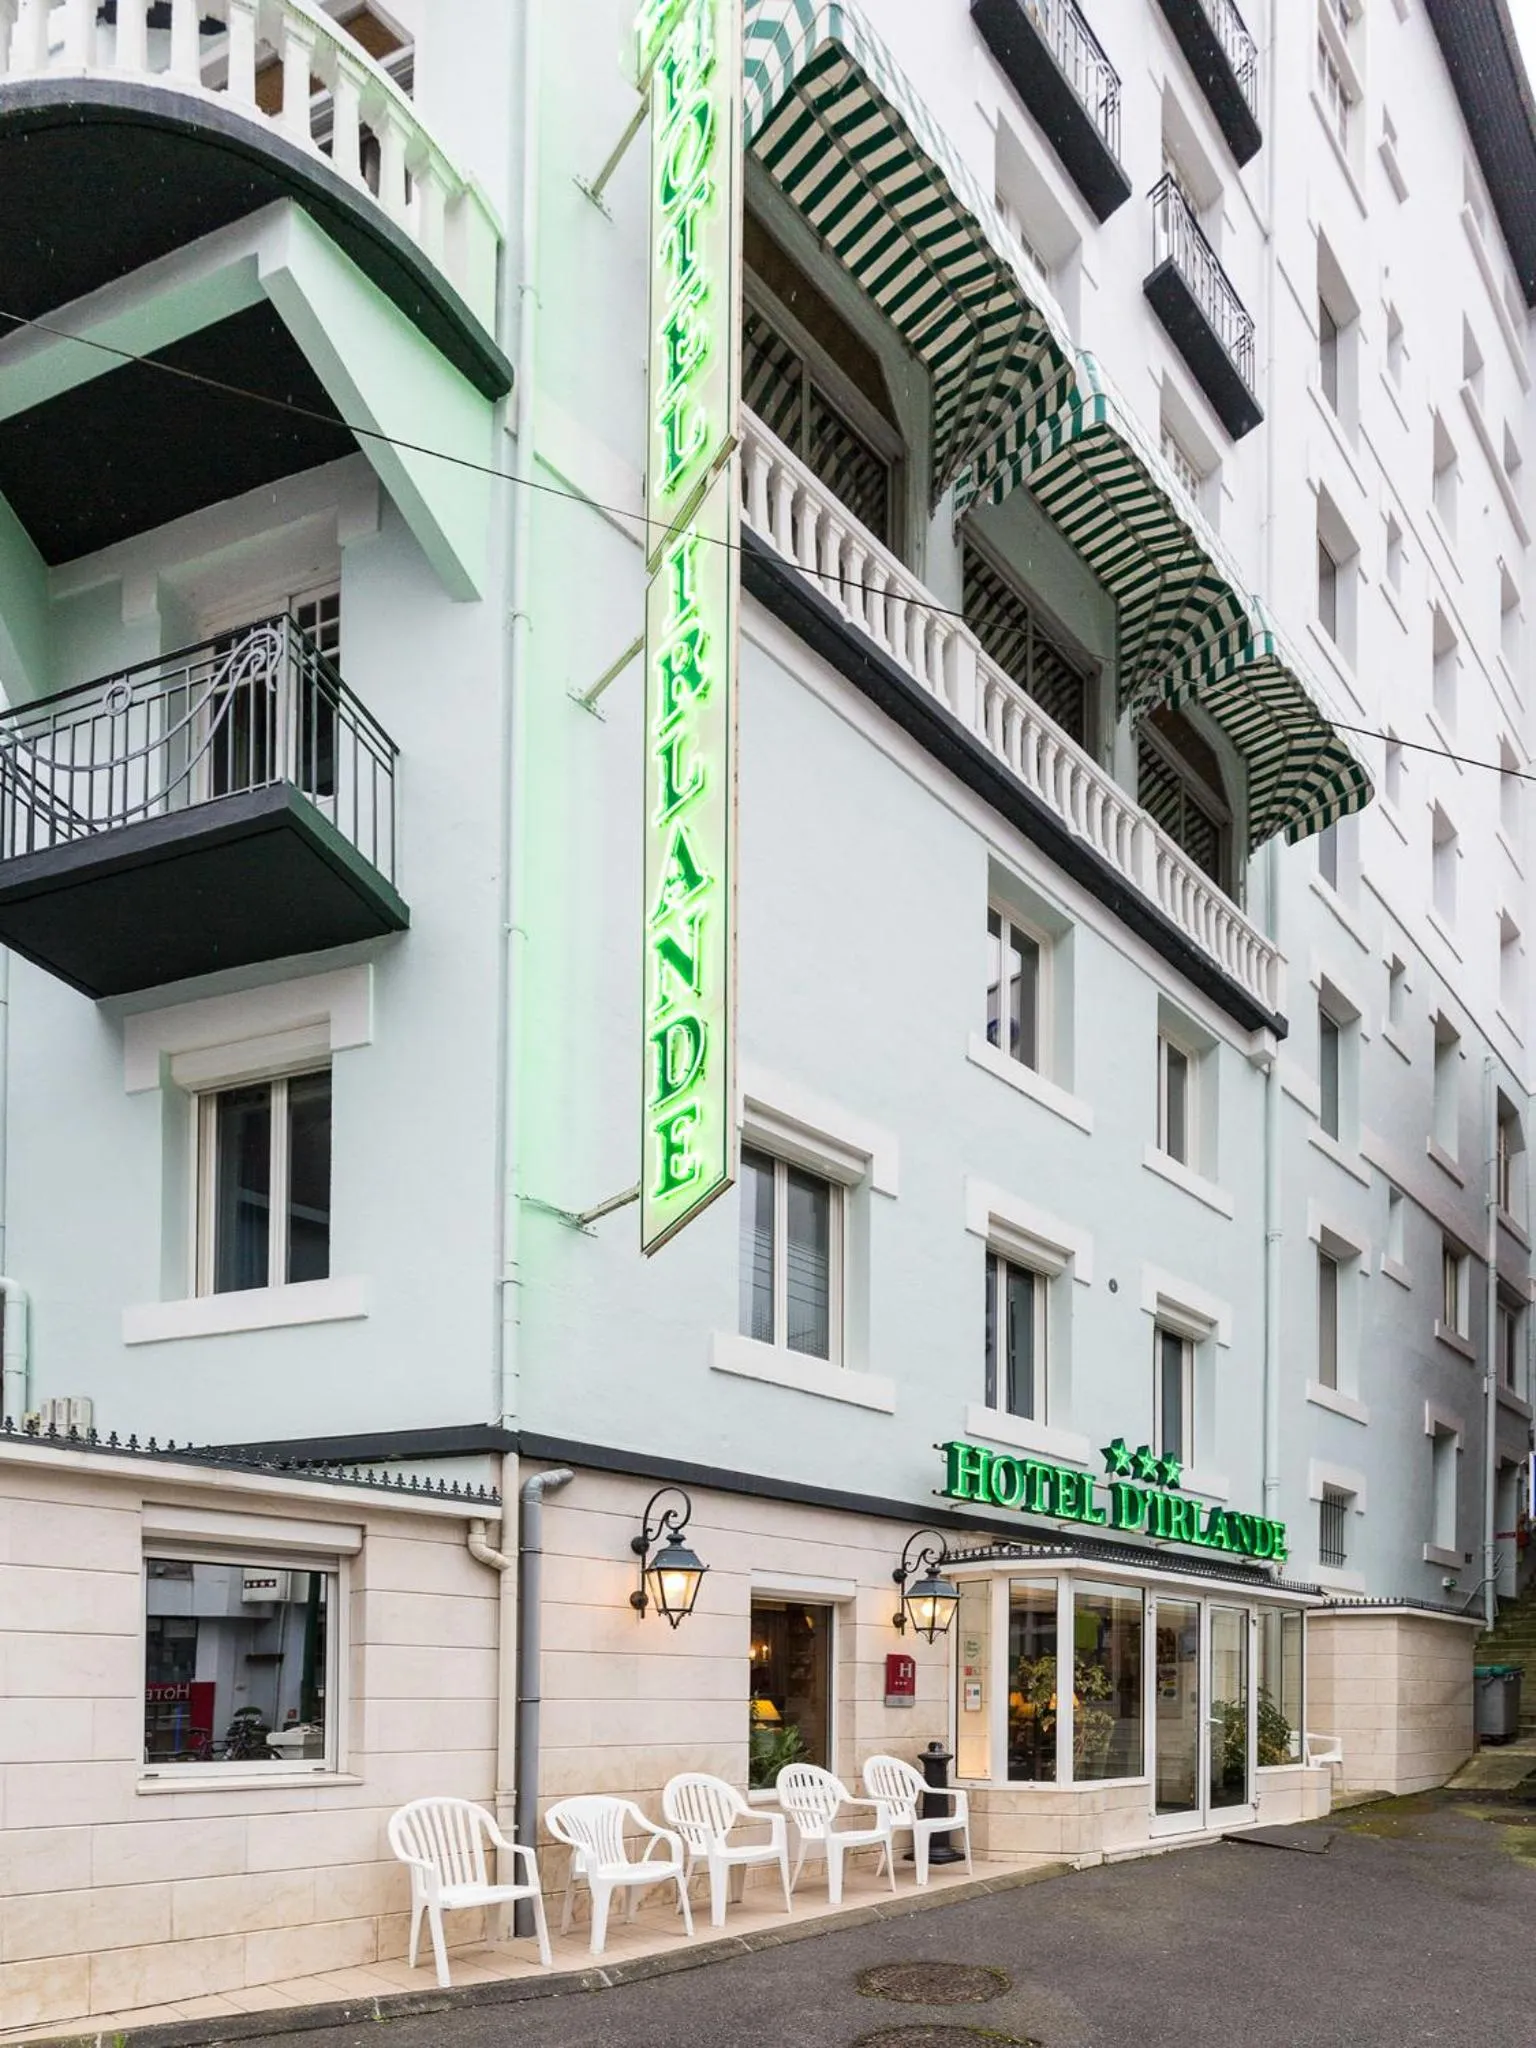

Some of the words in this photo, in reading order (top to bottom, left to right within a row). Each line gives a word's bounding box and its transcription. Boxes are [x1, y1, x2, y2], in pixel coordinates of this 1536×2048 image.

[655, 0, 714, 495] HOTEL
[649, 524, 709, 1201] IRLANDE
[945, 1441, 1106, 1525] HOTEL
[1108, 1481, 1288, 1561] D'IRLANDE
[899, 1662, 913, 1678] H
